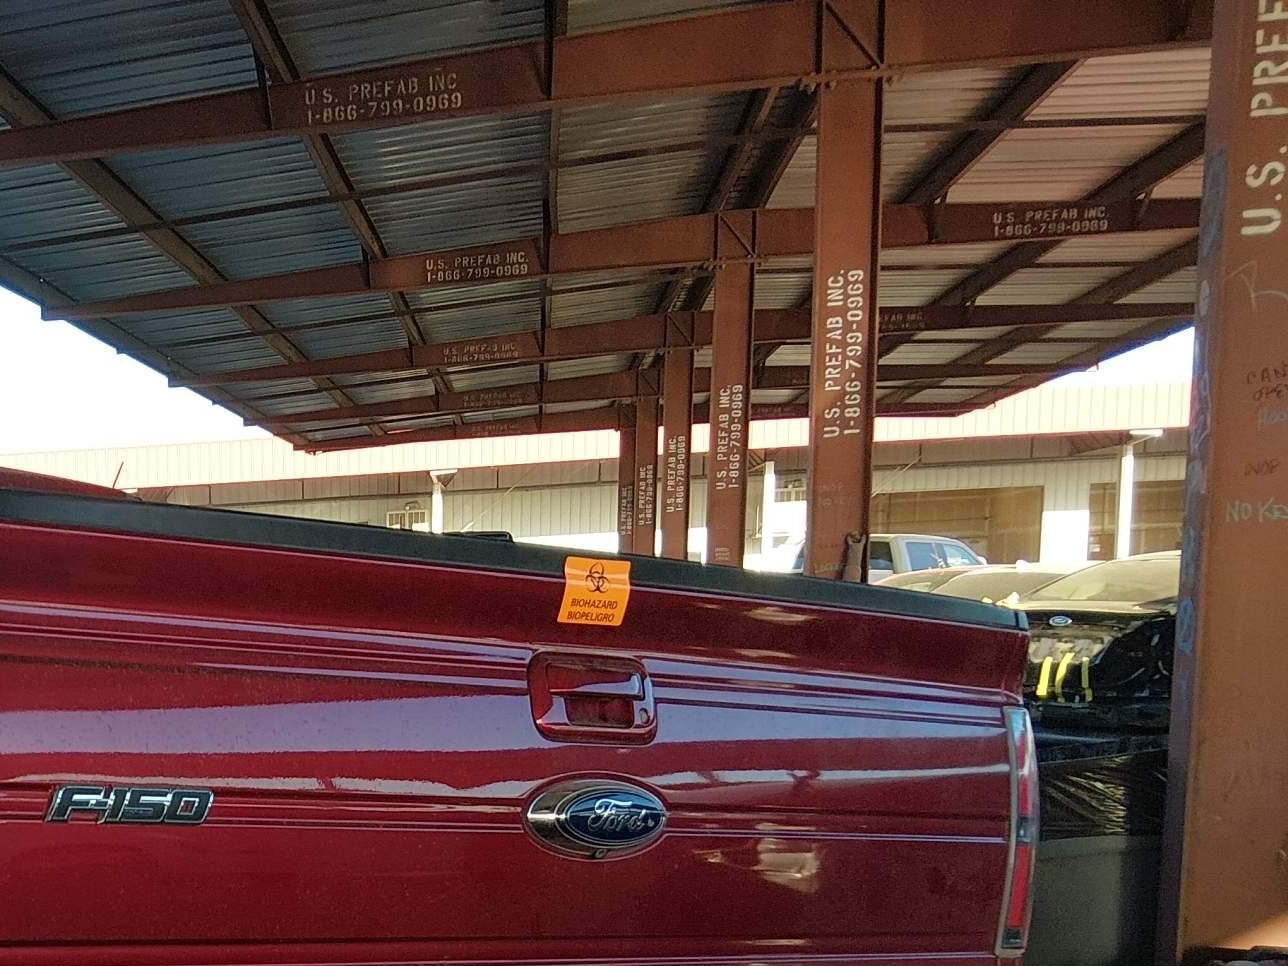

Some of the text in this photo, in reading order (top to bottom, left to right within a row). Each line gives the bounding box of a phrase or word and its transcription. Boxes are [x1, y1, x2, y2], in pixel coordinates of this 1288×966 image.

[349, 76, 419, 101] PREFAB
[307, 91, 462, 125] 1-866-799-0969
[1240, 144, 1288, 236] U.S.
[1025, 207, 1078, 222] PREFAB
[426, 251, 529, 271] U.S. PREFAB INC.
[824, 269, 845, 438] U.S. PREFAB INC.
[843, 269, 864, 436] 1-866-799-0969
[717, 413, 730, 461] PREFAB
[728, 384, 743, 489] 1-866-799-0969
[667, 456, 676, 492] PREFAB
[715, 468, 728, 490] U.S.
[567, 610, 615, 622] BIOPELIGRO
[570, 598, 618, 610] BIOHAZARD
[45, 785, 214, 825] F-150
[587, 798, 647, 833] Ford
